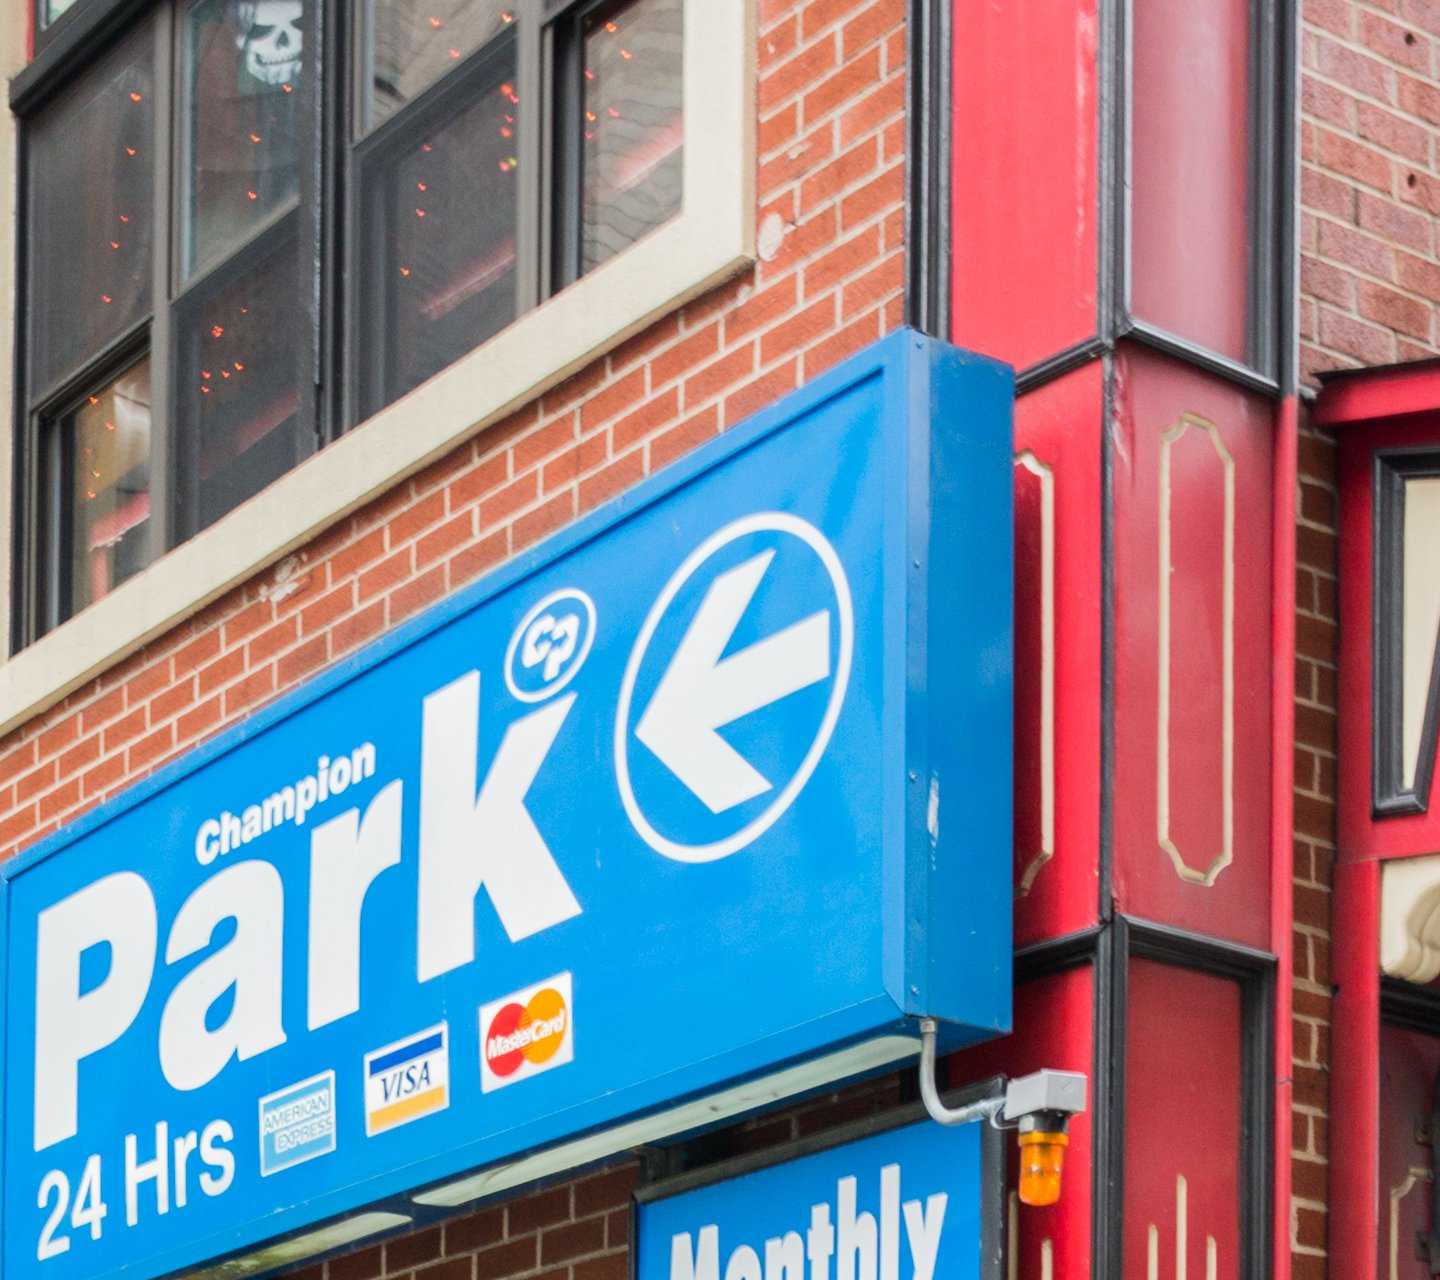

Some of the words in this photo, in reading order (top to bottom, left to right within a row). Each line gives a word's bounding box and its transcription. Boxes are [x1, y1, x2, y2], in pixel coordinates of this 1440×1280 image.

[196, 743, 375, 864] Champion
[34, 671, 582, 1151] Park
[487, 1008, 566, 1061] MasterCard
[380, 1061, 431, 1102] VISA
[263, 1089, 328, 1133] AMERICAN
[277, 1117, 333, 1152] EXPRESS
[37, 1155, 104, 1260] 24
[126, 1120, 234, 1226] Hrs
